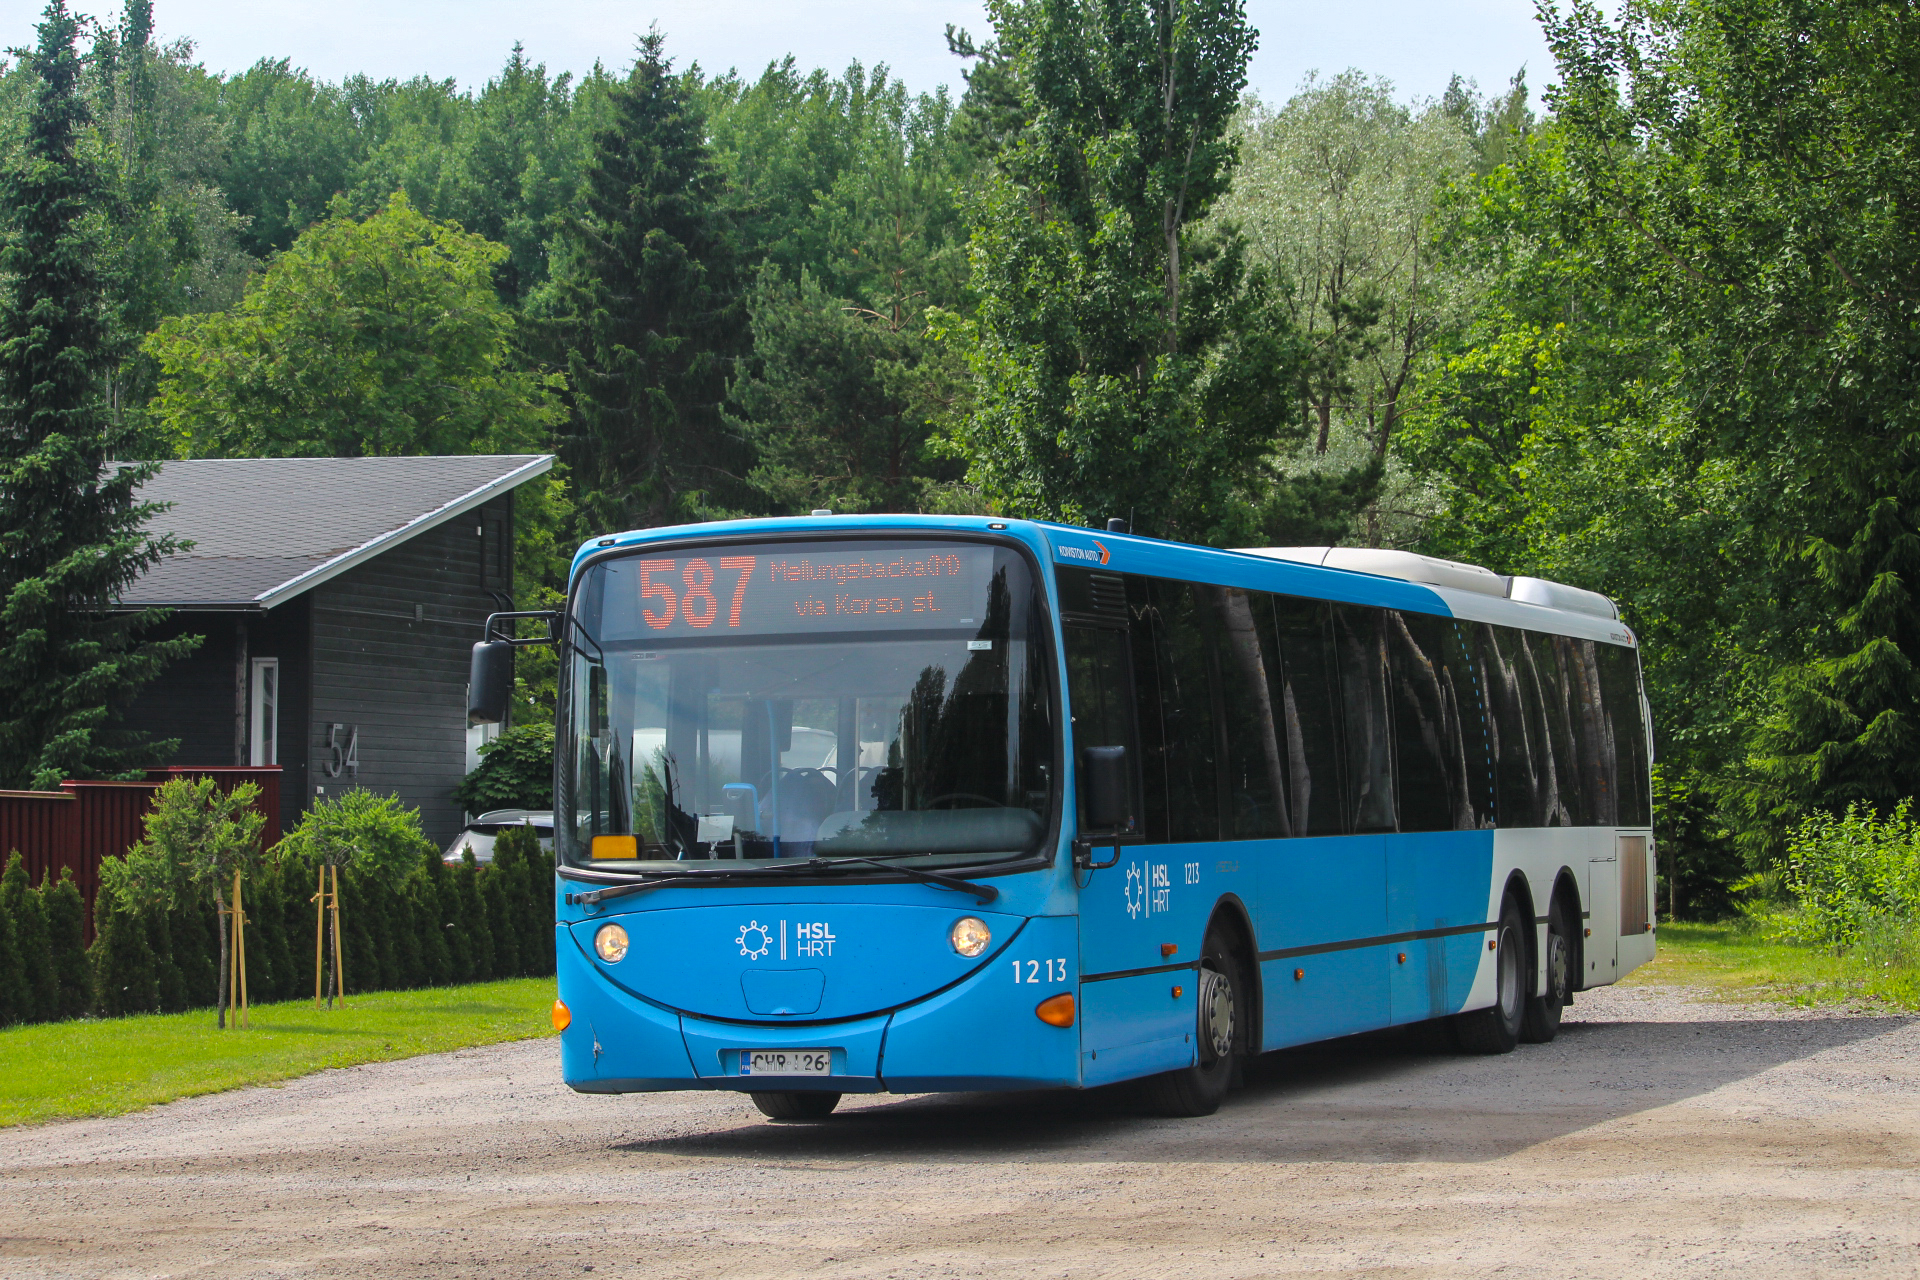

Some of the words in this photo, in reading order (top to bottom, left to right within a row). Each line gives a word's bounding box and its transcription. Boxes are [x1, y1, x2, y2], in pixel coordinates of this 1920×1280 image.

[639, 556, 756, 629] 587
[795, 595, 828, 616] via
[835, 593, 904, 614] Korso
[330, 723, 360, 778] 54
[1152, 864, 1170, 887] HSL
[1184, 862, 1200, 885] 1213
[1152, 888, 1170, 912] HRT
[797, 922, 836, 939] HSL
[797, 940, 836, 957] HRT
[1012, 958, 1067, 984] 1213
